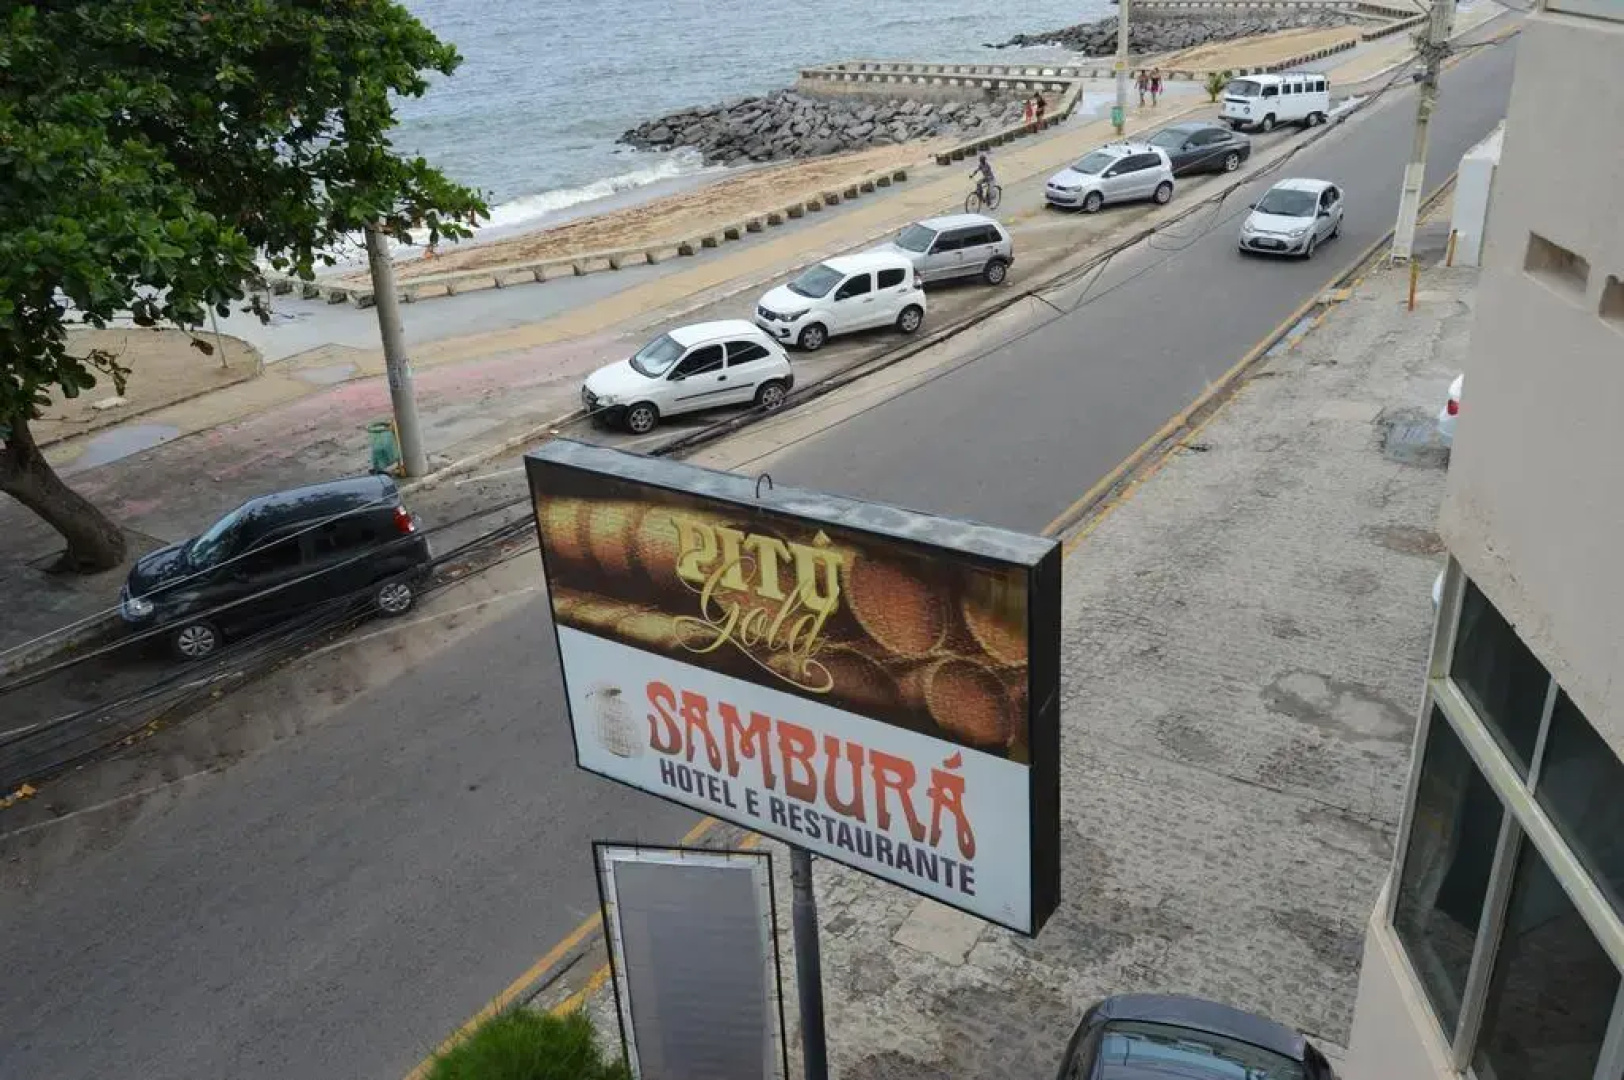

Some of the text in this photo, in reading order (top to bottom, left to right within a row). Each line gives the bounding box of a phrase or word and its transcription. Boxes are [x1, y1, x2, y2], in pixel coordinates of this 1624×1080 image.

[674, 556, 834, 693] Gold
[646, 681, 976, 861] SAMBURÁ
[659, 757, 975, 897] HOTEL E RESTAURANTE
